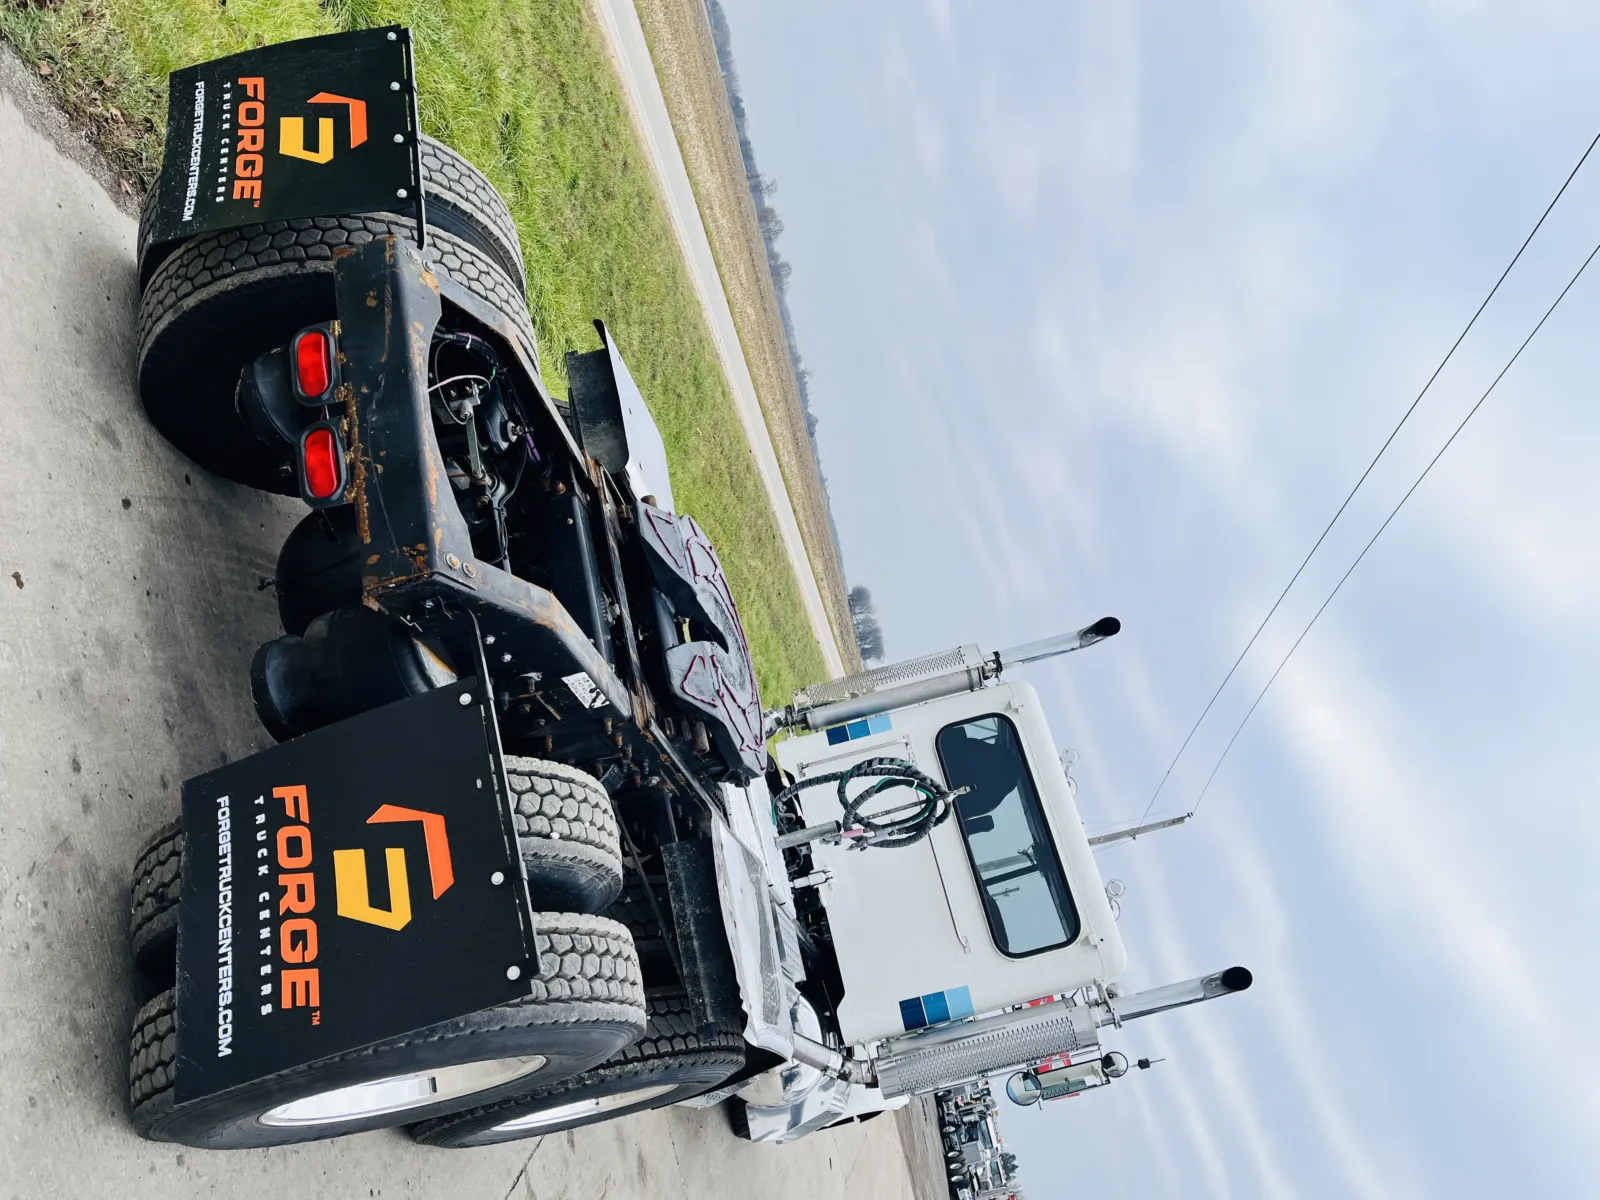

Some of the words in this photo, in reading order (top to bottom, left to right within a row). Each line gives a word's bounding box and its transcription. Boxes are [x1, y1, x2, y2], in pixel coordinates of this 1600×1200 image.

[181, 80, 205, 222] FORGETRUCKCENTERS.COM
[221, 81, 231, 130] TRUCK
[233, 76, 264, 200] FORGE
[216, 137, 230, 203] CENTERS
[254, 794, 269, 877] TRUCK
[273, 785, 320, 1009] FORGE
[216, 795, 233, 1058] FORGETRUCKCENTERS.COM
[258, 891, 273, 1016] CENTERS
